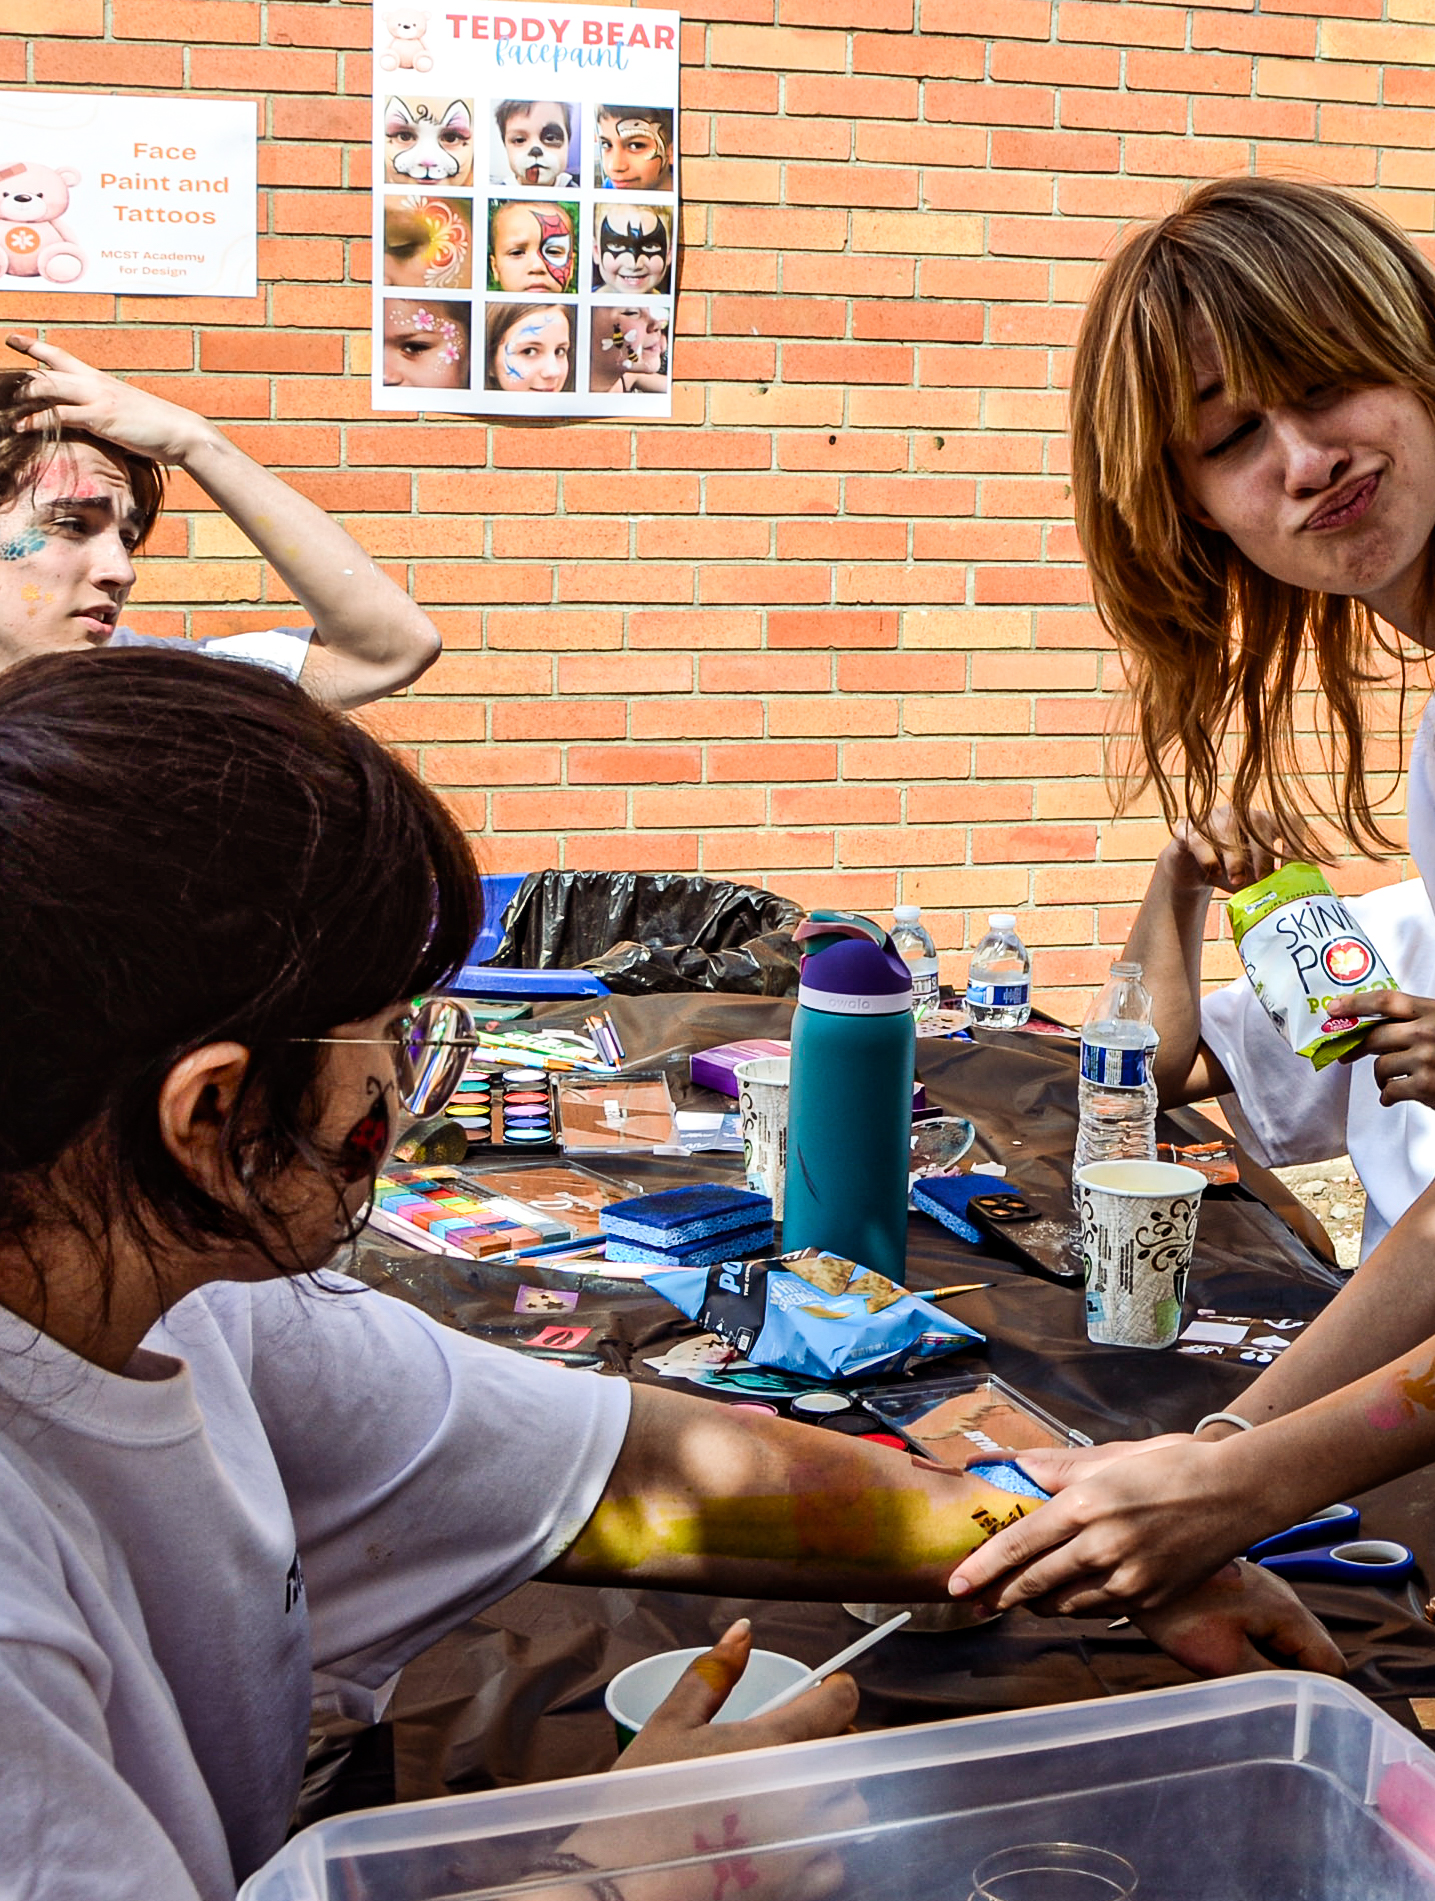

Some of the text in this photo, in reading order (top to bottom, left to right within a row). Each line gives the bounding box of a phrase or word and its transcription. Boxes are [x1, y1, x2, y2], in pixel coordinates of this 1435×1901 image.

[446, 14, 675, 50] TEDDY BEAR
[496, 36, 629, 72] facepaint
[134, 143, 197, 160] Face
[101, 173, 229, 193] Paint and
[113, 206, 216, 224] Tattoos
[101, 250, 205, 263] MCST Academy
[119, 265, 187, 277] for Design
